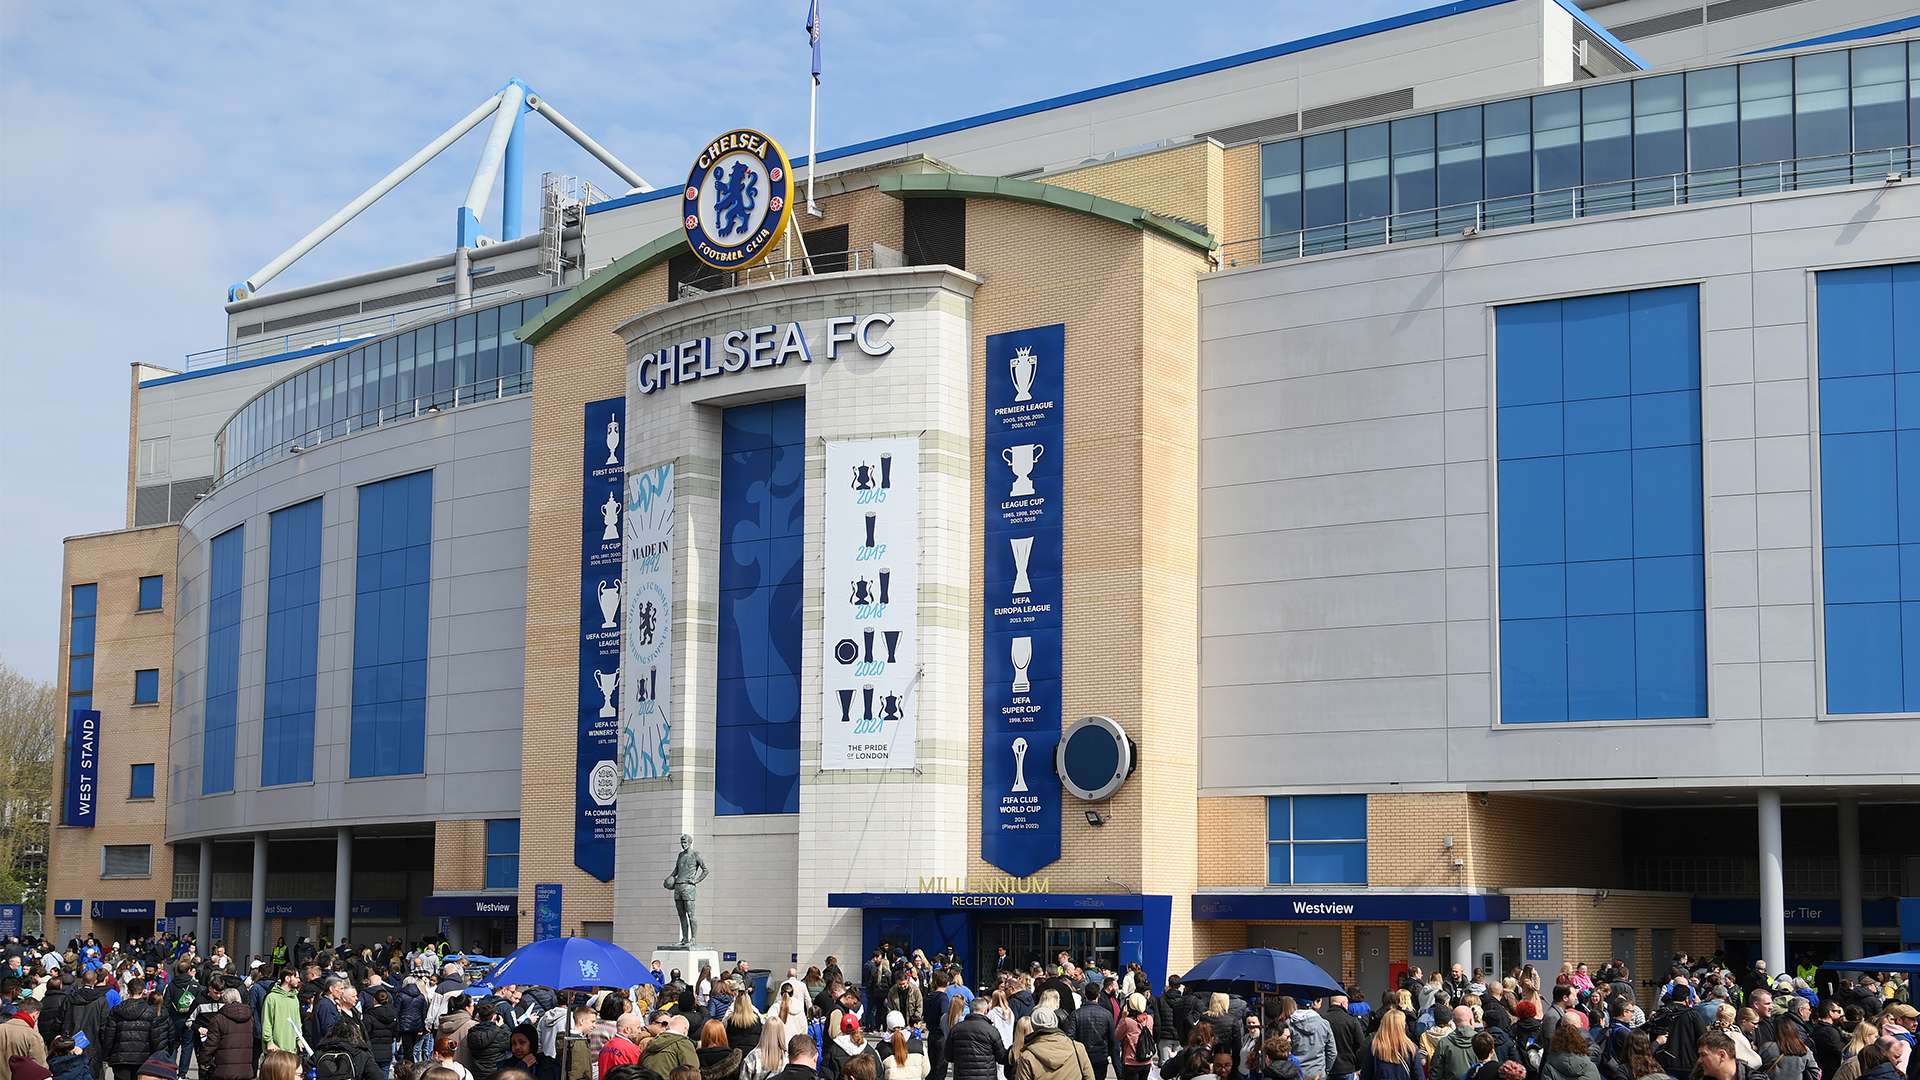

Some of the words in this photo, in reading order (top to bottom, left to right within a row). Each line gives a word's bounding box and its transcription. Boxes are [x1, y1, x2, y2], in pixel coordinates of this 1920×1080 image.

[699, 133, 768, 168] CHELSEA
[698, 242, 744, 261] FOOTBALL
[746, 228, 770, 252] CLUB
[637, 321, 812, 394] CHELSEA
[826, 312, 895, 360] FC
[994, 405, 1025, 415] PREMIER
[1026, 401, 1054, 411] LEAGUE
[857, 488, 886, 504] 2015
[1002, 500, 1028, 509] LEAGUE
[632, 544, 656, 560] MADE
[658, 540, 669, 553] IN
[856, 544, 886, 561] 2017
[856, 604, 886, 620] 2018
[994, 607, 1022, 615] EUROPA
[1024, 604, 1051, 612] LEAGUE
[855, 660, 885, 676] 2020
[854, 718, 884, 734] 2021
[82, 720, 94, 768] STAND
[79, 774, 91, 815] WEST
[920, 876, 1049, 893] MILLENNIUM
[476, 902, 510, 912] Westview
[952, 896, 1014, 906] RECEPTION
[1293, 902, 1354, 914] Westview
[1798, 907, 1823, 918] Tier
